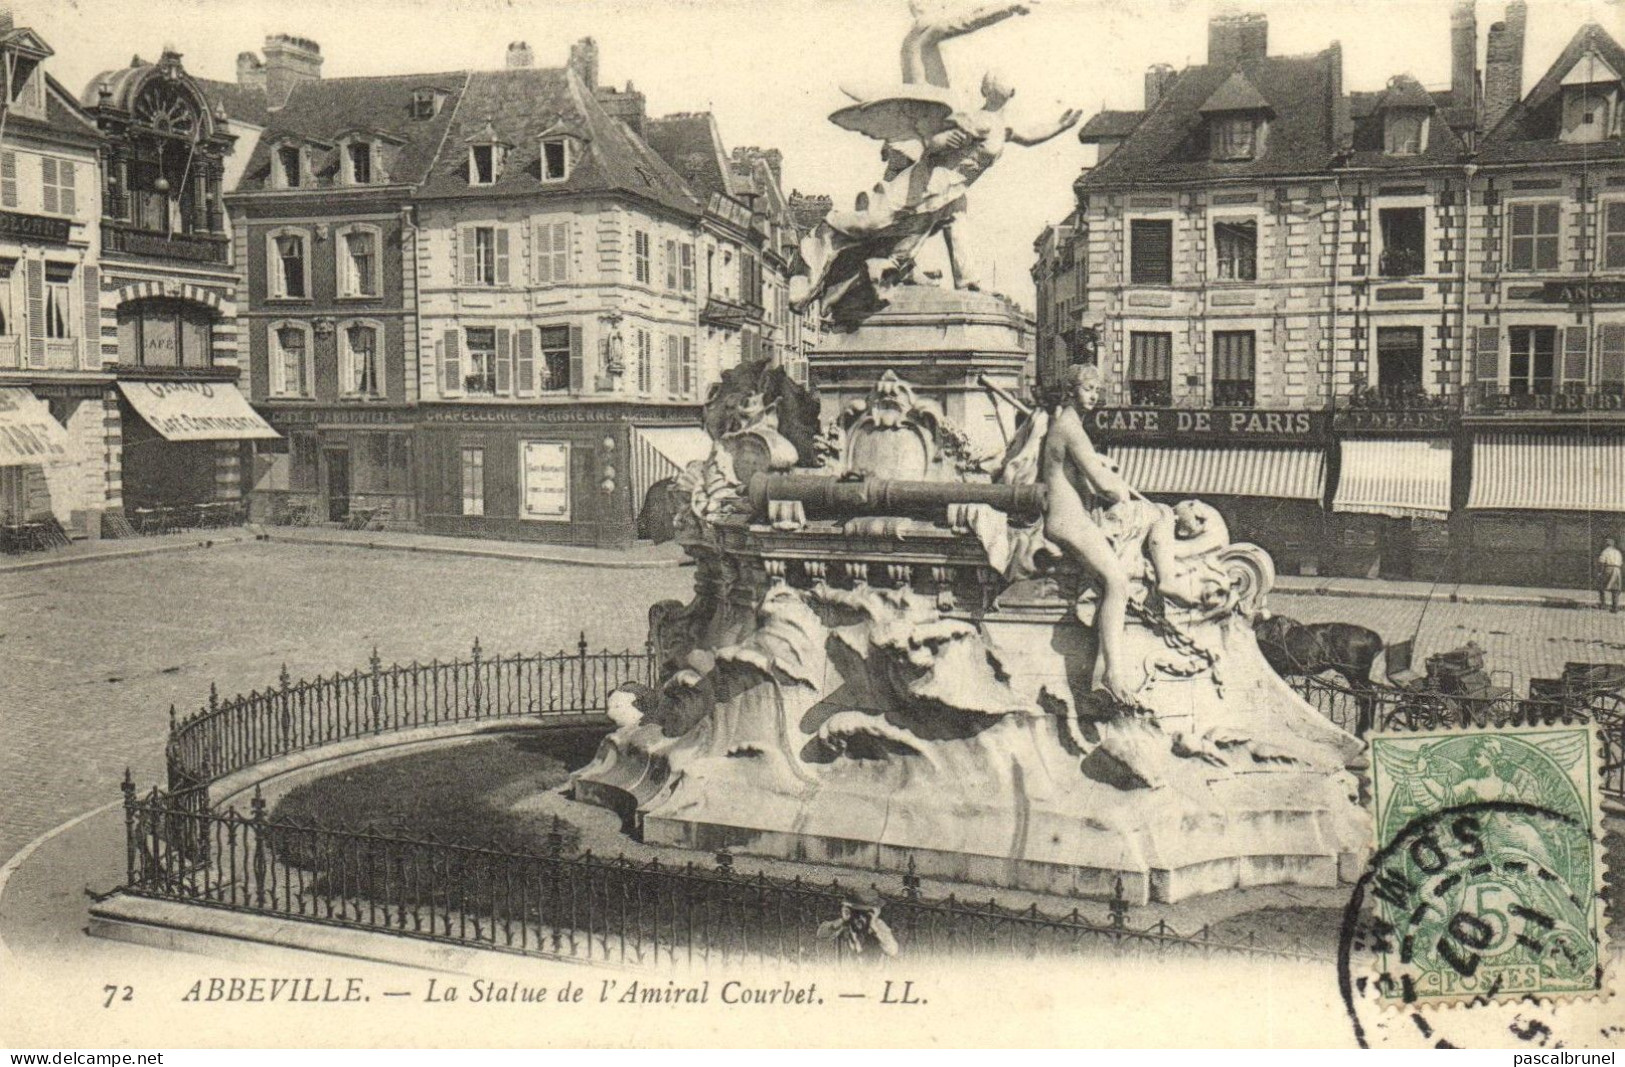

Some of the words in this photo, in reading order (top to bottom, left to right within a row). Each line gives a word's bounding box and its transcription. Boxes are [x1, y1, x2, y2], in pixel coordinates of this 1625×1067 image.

[425, 411, 519, 422] CHAPELLERIE
[528, 411, 615, 422] PARISIENNE
[1094, 410, 1159, 431] CAFE
[1176, 411, 1211, 432] DE
[1229, 412, 1311, 433] PARIS
[1444, 966, 1539, 993] POSTES
[103, 983, 134, 1008] 72
[182, 977, 371, 1003] ABBEVILLE.
[424, 978, 458, 1003] La
[469, 978, 547, 1003] Statue
[557, 980, 584, 1003] de
[720, 980, 824, 1005] Courbet.
[879, 980, 929, 1005] LL.
